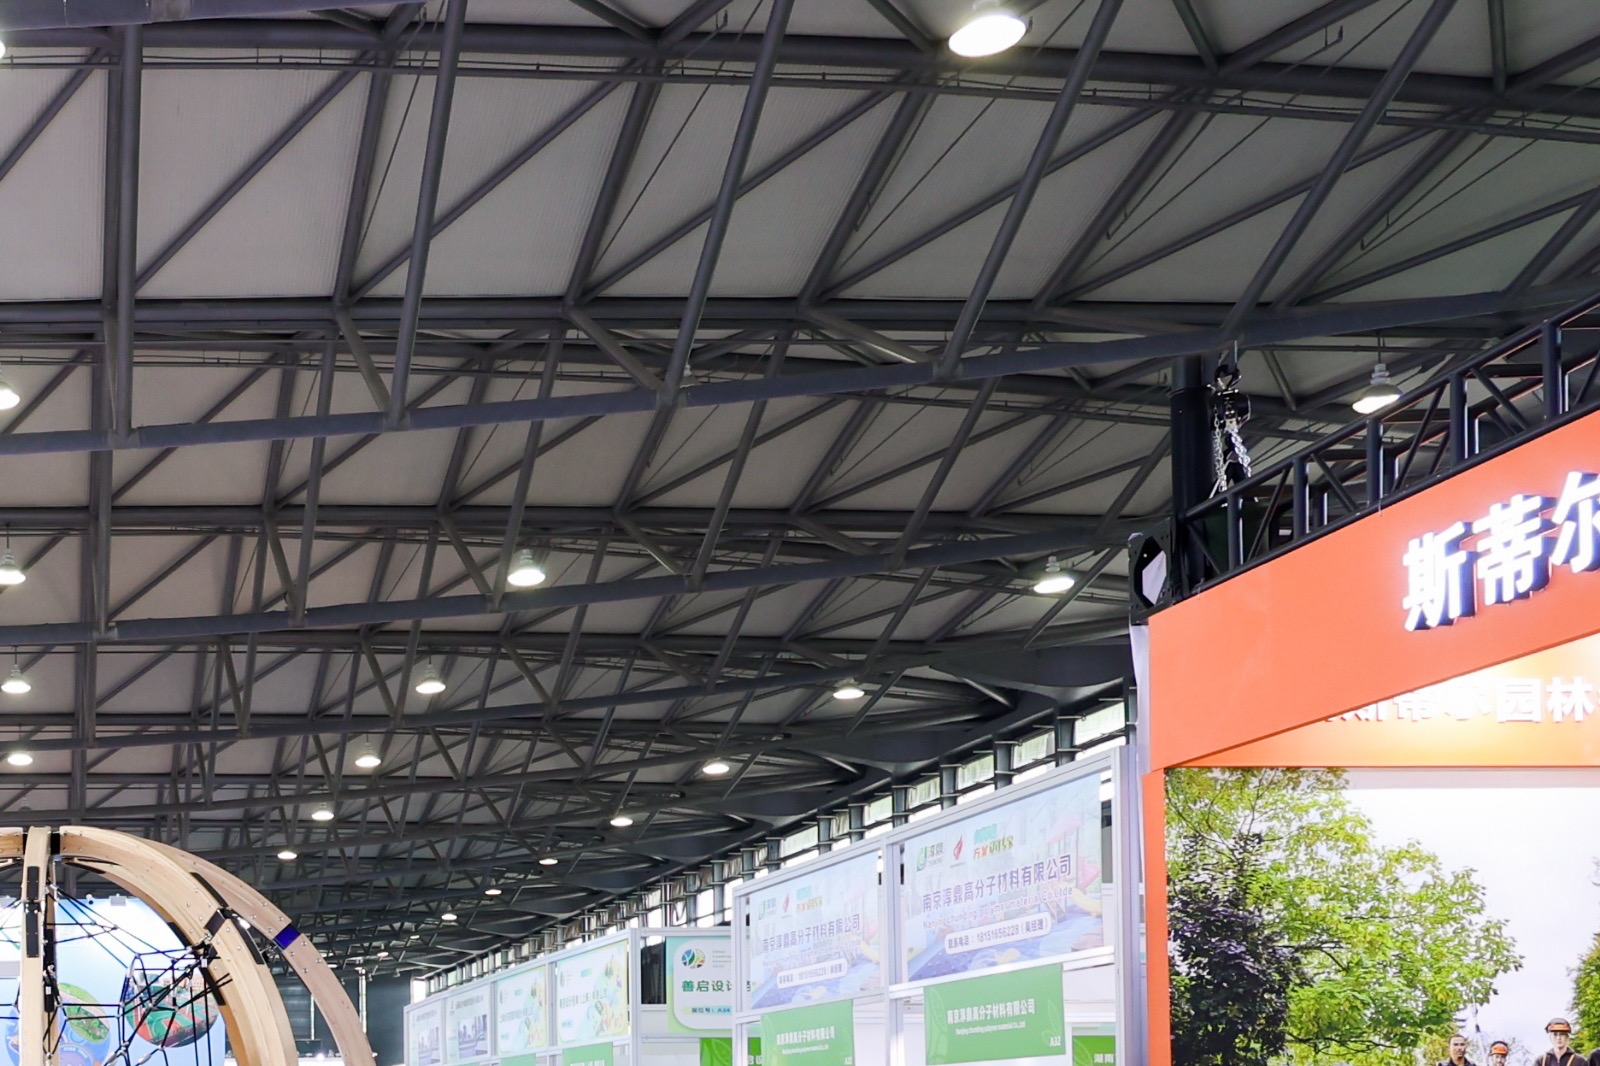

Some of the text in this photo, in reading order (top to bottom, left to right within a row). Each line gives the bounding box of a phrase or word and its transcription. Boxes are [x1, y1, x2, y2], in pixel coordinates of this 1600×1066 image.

[1403, 471, 1600, 632] 斯蒂尔
[923, 854, 1071, 913] 南京淳鼎高分子材料有限公司
